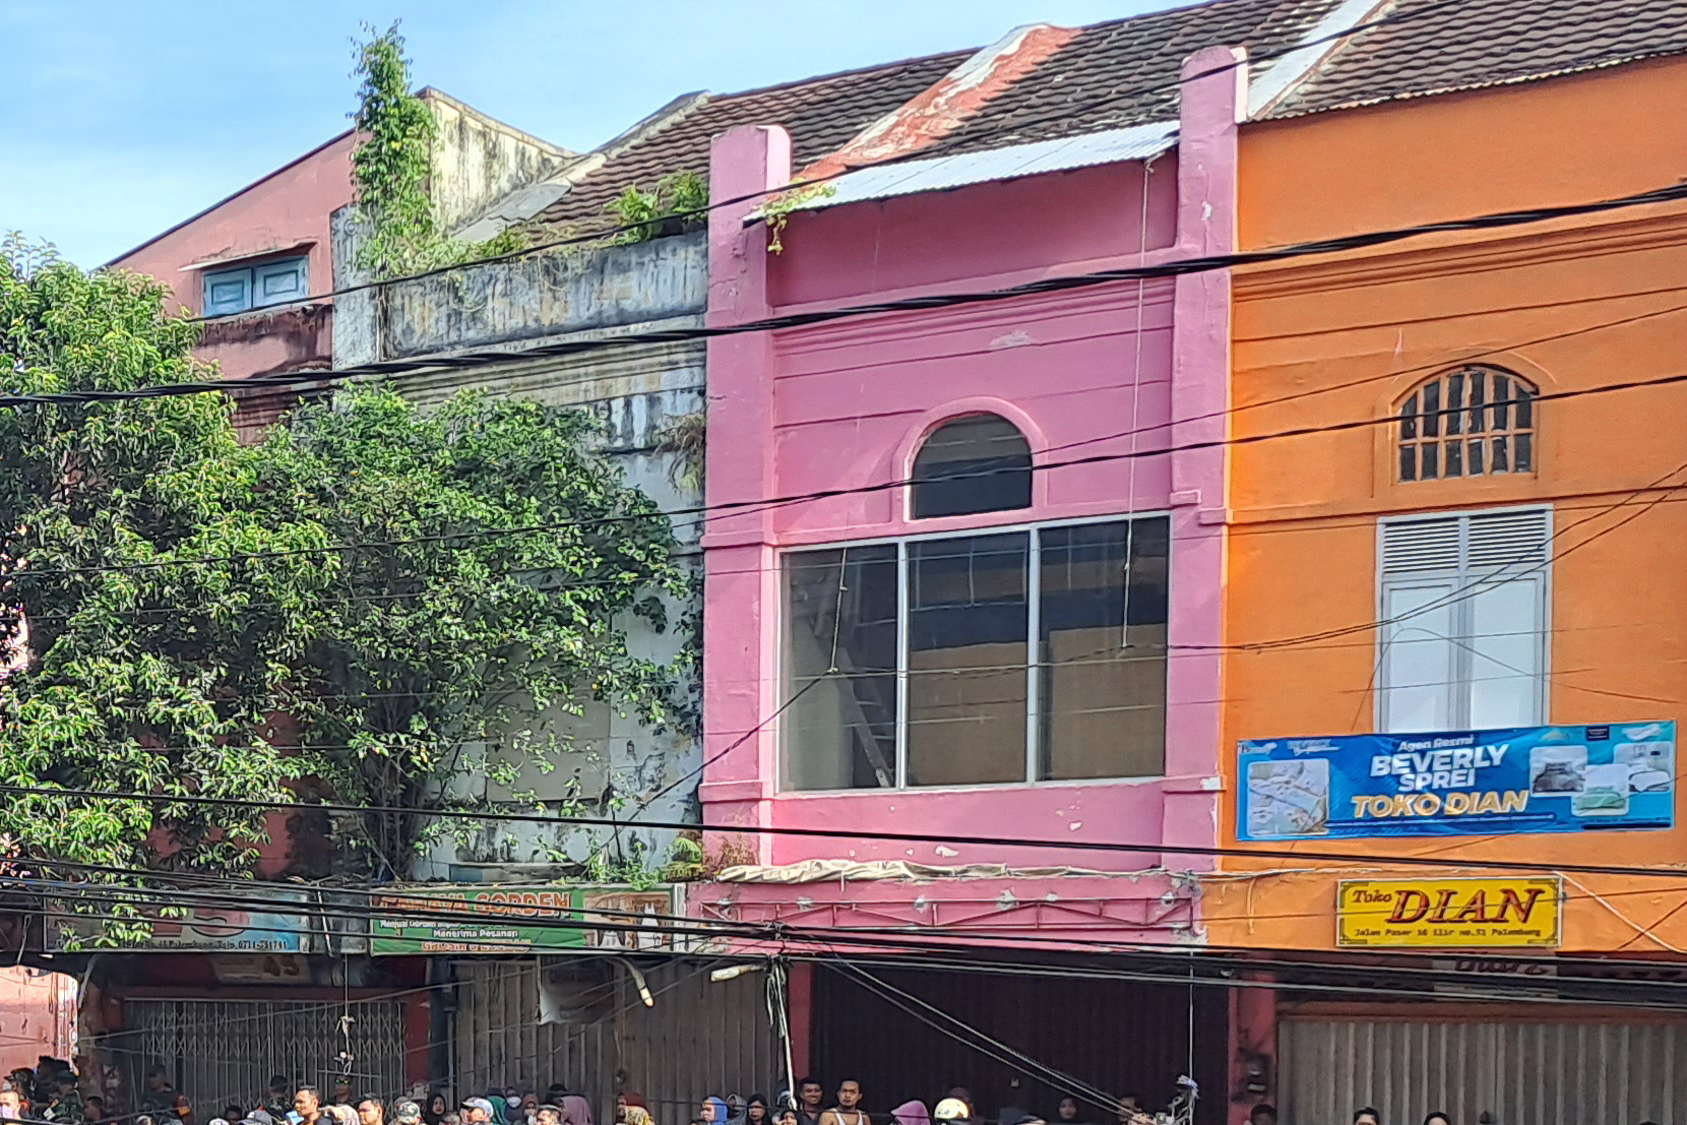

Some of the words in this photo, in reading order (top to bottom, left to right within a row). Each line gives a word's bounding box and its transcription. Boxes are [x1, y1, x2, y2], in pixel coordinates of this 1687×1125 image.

[1370, 743, 1510, 777] BEVERLY
[1398, 768, 1476, 792] SPREI
[1351, 792, 1441, 819] TOKO
[1444, 789, 1530, 816] DIAN
[474, 892, 571, 917] GORDEN
[1352, 889, 1392, 903] Toko
[1385, 888, 1545, 924] DIAN
